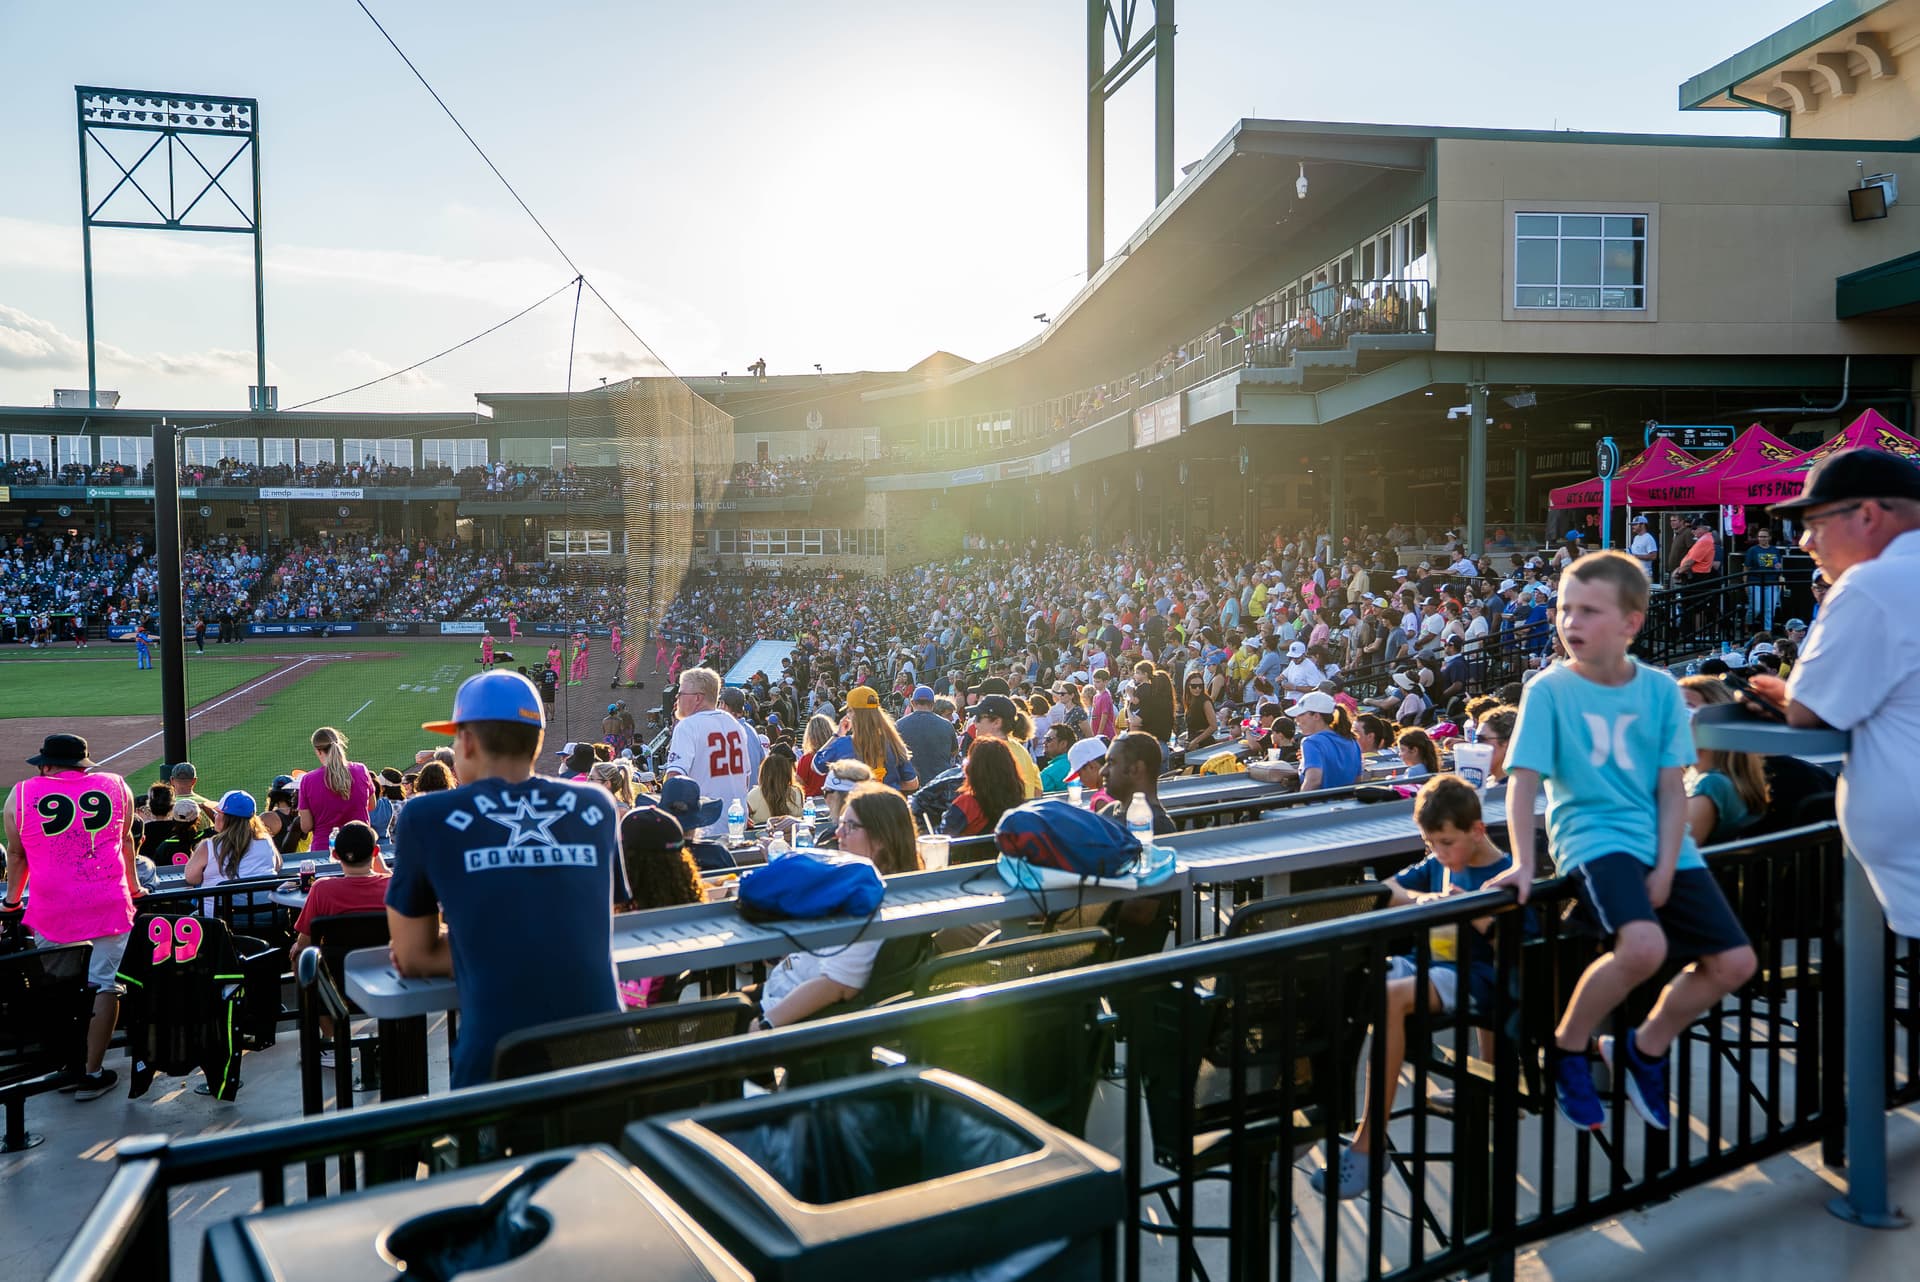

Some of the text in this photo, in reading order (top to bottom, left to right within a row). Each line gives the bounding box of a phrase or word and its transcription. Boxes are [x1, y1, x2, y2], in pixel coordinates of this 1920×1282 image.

[1648, 487, 1667, 500] LET'S
[1748, 484, 1772, 497] LET'S
[707, 731, 744, 777] 26
[37, 790, 112, 837] 99
[445, 789, 604, 831] DALLAS
[470, 848, 593, 869] COWBOYS
[148, 916, 203, 965] 99
